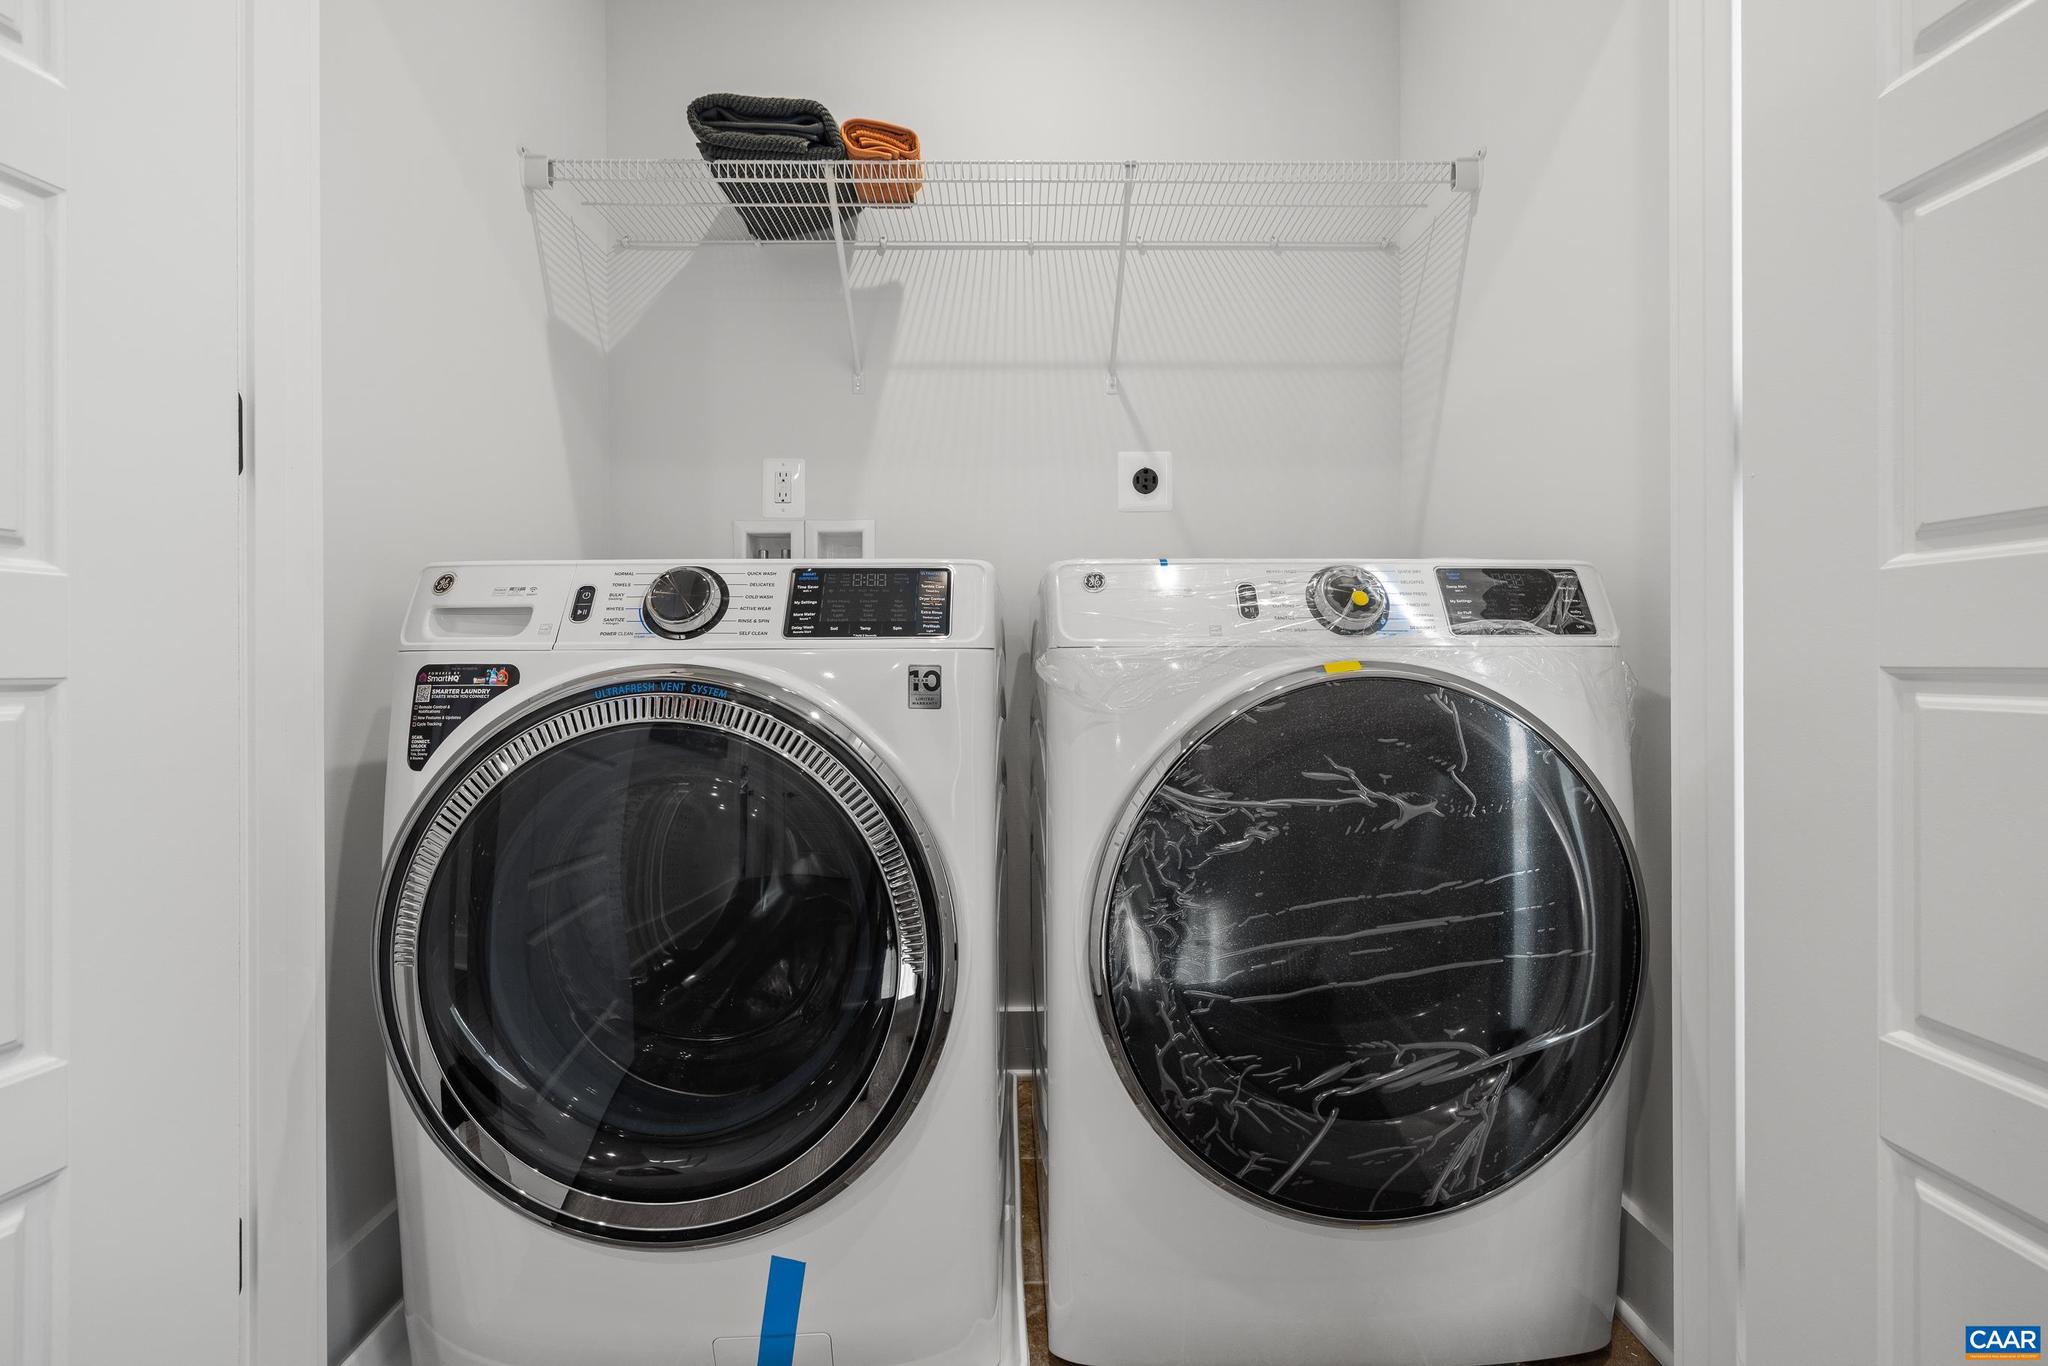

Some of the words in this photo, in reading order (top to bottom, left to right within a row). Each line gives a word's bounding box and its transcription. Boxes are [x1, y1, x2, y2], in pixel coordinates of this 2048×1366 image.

[427, 674, 460, 683] SmartHQ
[909, 670, 941, 691] 10
[594, 682, 655, 699] ULTRAFRESH
[659, 682, 686, 692] VENT
[690, 683, 729, 699] SYSTEM
